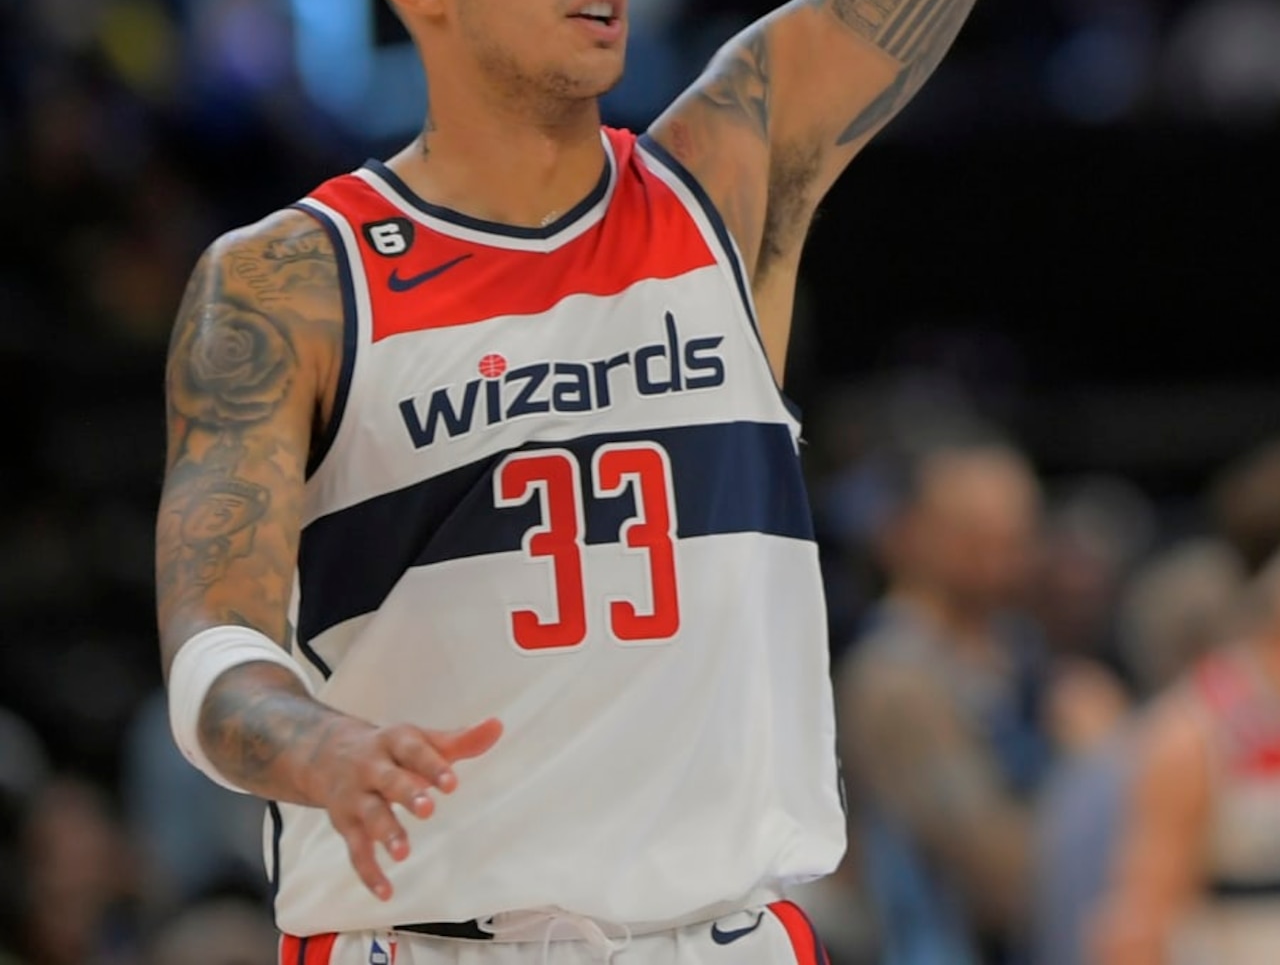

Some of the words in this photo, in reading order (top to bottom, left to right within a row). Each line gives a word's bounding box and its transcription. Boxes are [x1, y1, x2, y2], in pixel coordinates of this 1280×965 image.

[370, 223, 406, 254] 6
[399, 311, 725, 449] wizards
[496, 443, 680, 652] 33
